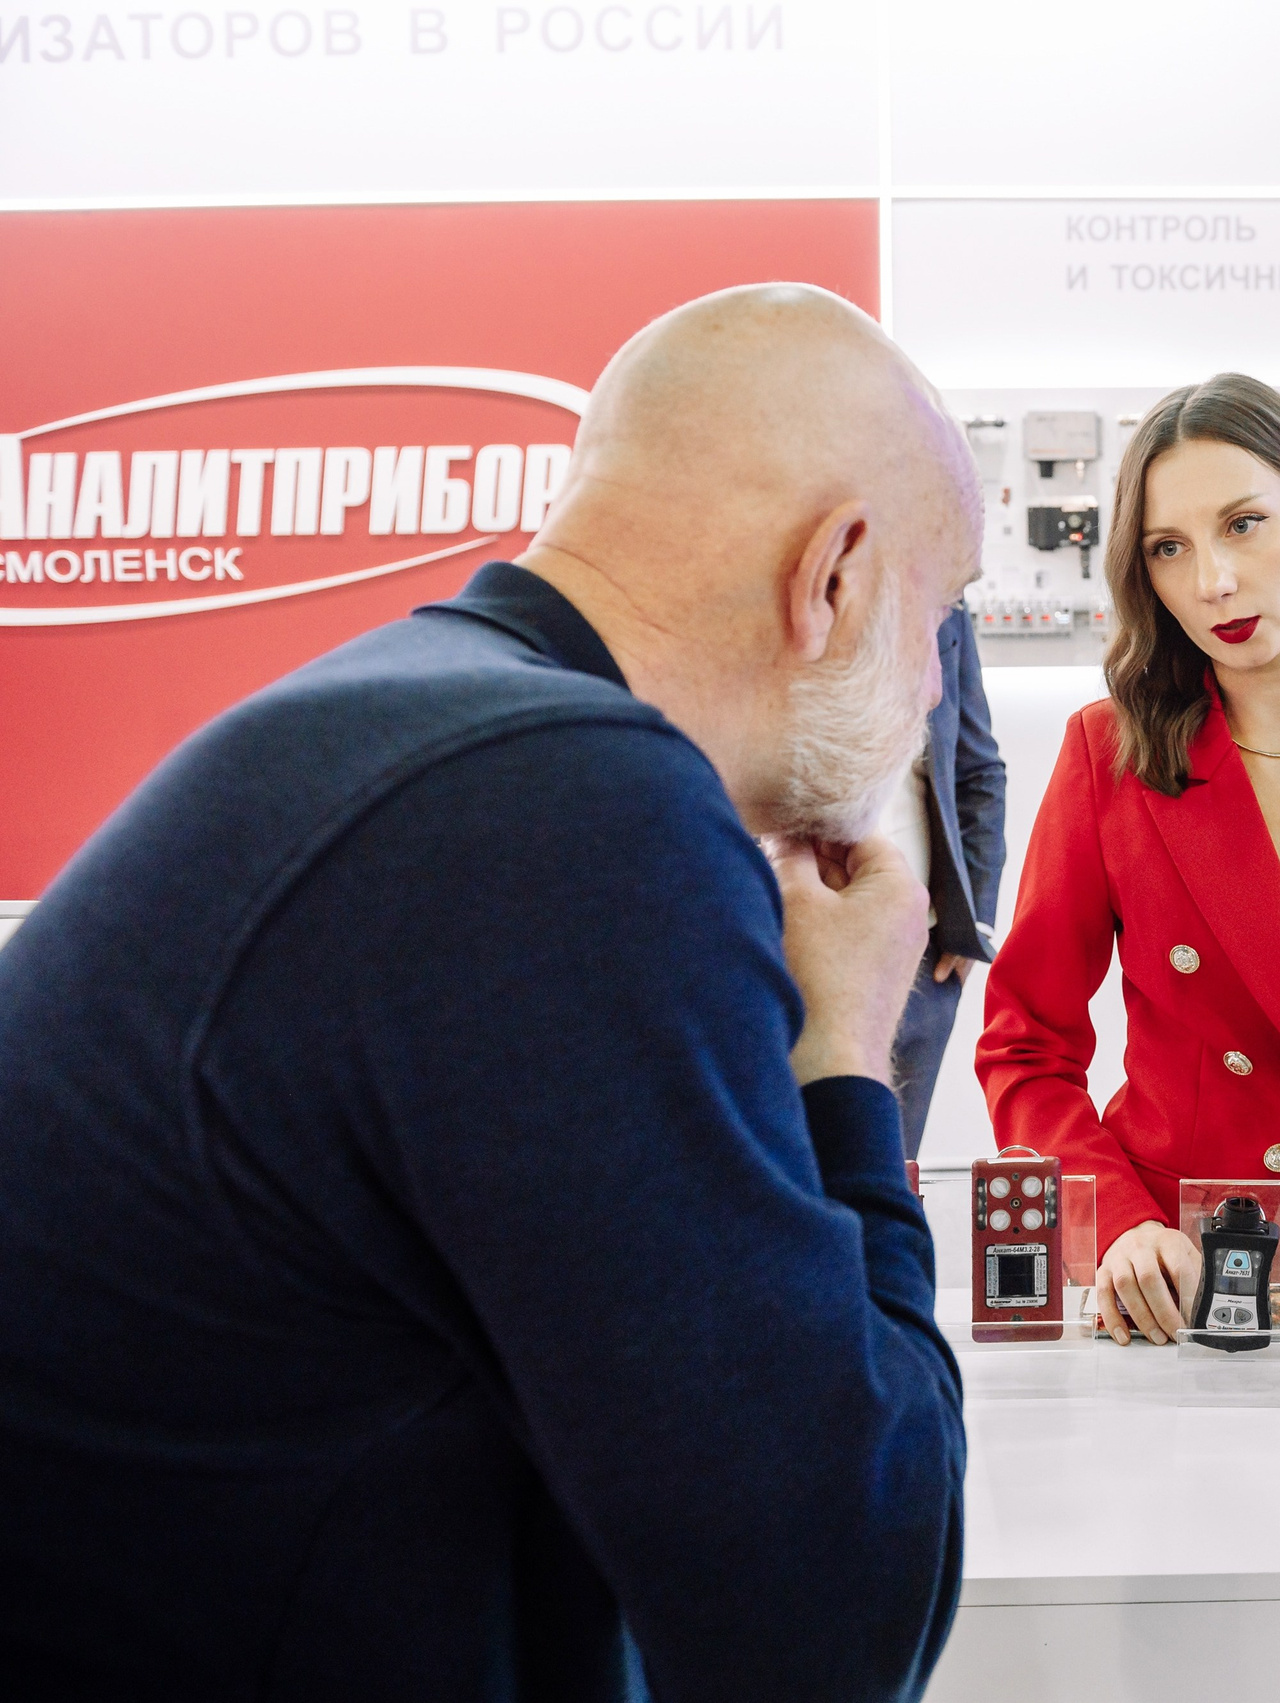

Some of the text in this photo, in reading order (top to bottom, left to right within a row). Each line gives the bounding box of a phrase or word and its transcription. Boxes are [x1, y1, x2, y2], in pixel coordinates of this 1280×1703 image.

[0, 4, 785, 64] ИЗАТОРОВ В РОССИИ
[1067, 215, 1255, 242] КОНТРОЛЬ
[1067, 264, 1088, 291] И
[0, 547, 243, 583] МОЛЕНСК
